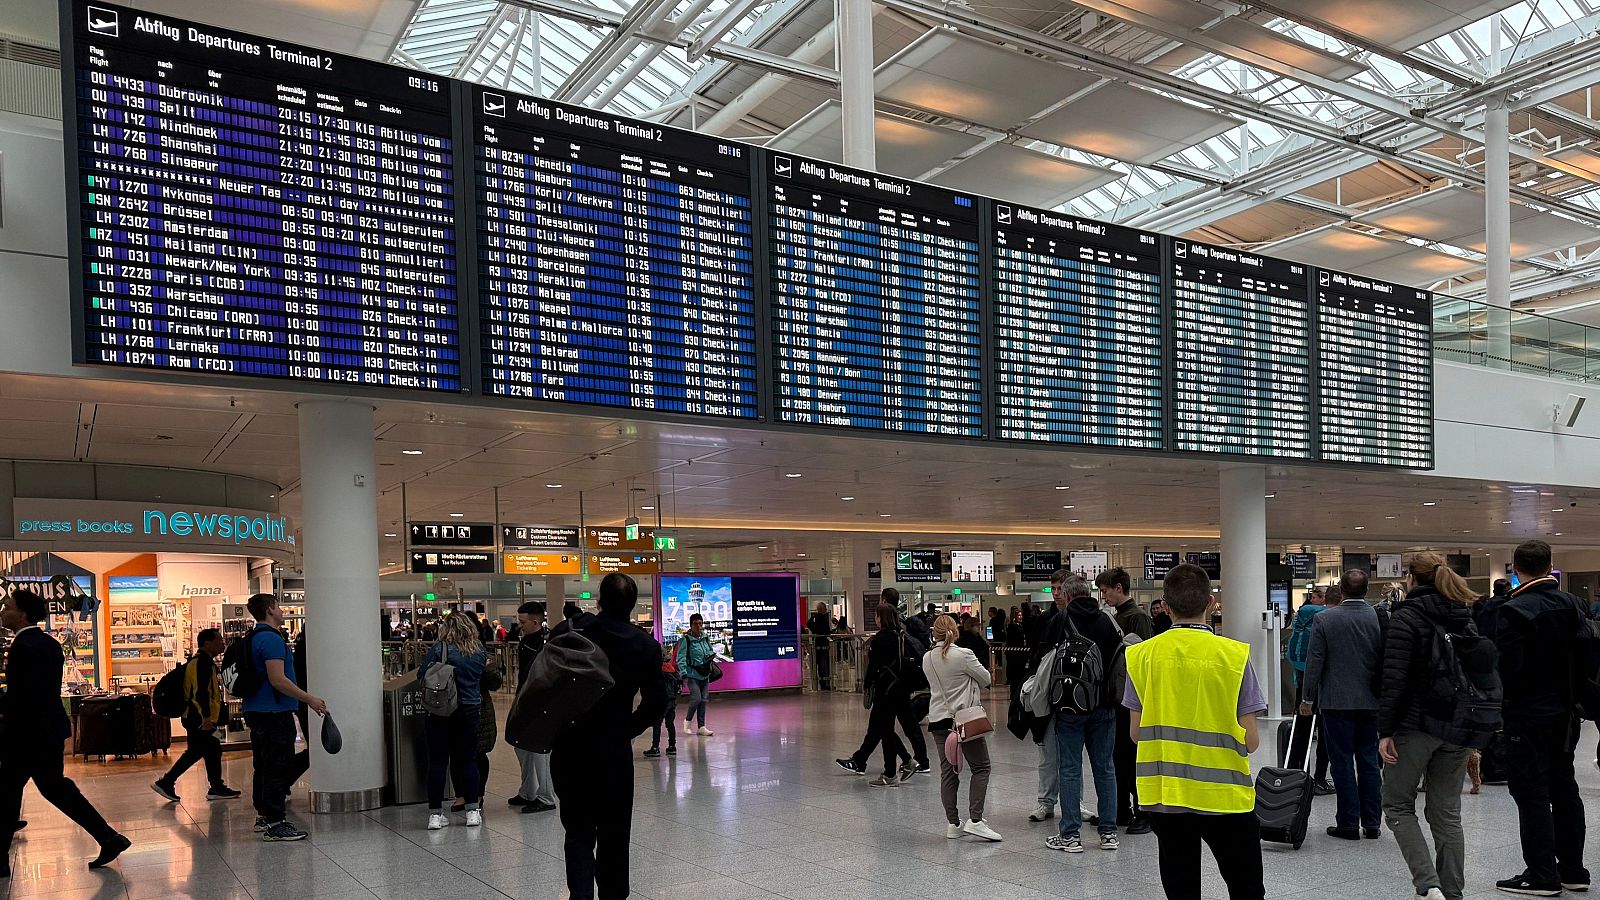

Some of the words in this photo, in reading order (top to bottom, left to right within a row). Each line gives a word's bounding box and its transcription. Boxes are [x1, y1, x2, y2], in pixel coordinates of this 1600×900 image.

[90, 46, 104, 56] Flug
[134, 16, 179, 41] Abflug
[188, 27, 260, 55] Departures
[267, 44, 320, 68] Terminal
[324, 57, 332, 70] 2
[90, 56, 108, 66] Flight
[158, 61, 173, 69] nach
[408, 76, 438, 92] 09:16
[90, 71, 106, 85] OU
[113, 75, 144, 92] 4433
[158, 84, 223, 107] Dubrovnik
[278, 107, 311, 123] 20:15
[318, 114, 349, 130] 17:30
[355, 121, 374, 135] K16
[380, 126, 417, 143] Abflug
[422, 137, 440, 148] vom
[278, 94, 306, 105] scheduled
[317, 102, 344, 112] estimated
[355, 99, 368, 108] Gate
[380, 104, 402, 114] Check-in
[516, 99, 549, 119] Abflug
[556, 107, 608, 130] Departures
[613, 120, 653, 139] Terminal
[656, 129, 662, 141] 2
[92, 124, 108, 137] LH
[123, 129, 146, 143] 726
[160, 136, 217, 155] Shanghai
[280, 156, 312, 171] 22:20
[320, 162, 351, 178] 14:00
[357, 169, 376, 182] L03
[382, 173, 418, 189] Abflug
[424, 182, 442, 193] vom
[718, 144, 740, 157] 09:16
[799, 161, 825, 179] Abflug
[829, 168, 870, 186] Departures
[873, 177, 903, 194] Terminal
[905, 185, 910, 195] 2
[219, 179, 254, 193] Neuer
[260, 185, 280, 198] Tag
[307, 194, 332, 206] next
[339, 198, 358, 210] day
[95, 195, 111, 206] SN
[118, 198, 148, 212] 2642
[163, 204, 212, 220] Brüssel
[282, 221, 315, 235] 08:55
[321, 227, 353, 241] 09:20
[359, 232, 378, 244] K15
[384, 237, 444, 254] aufgerufen
[487, 206, 498, 217] A3
[509, 209, 524, 222] 501
[536, 214, 598, 234] Thessaloniki
[624, 229, 648, 243] 10:15
[680, 239, 695, 251] K16
[699, 242, 735, 258] Check-in
[1017, 208, 1037, 224] Abflug
[1040, 213, 1073, 229] Departures
[1075, 220, 1100, 234] Terminal
[1101, 225, 1105, 235] 2
[1191, 244, 1207, 257] Abflug
[1210, 248, 1236, 261] Departures
[1238, 253, 1258, 266] Terminal
[1259, 258, 1262, 266] 2
[98, 247, 113, 258] UA
[128, 250, 149, 262] 031
[165, 255, 236, 273] Newark/New
[244, 265, 270, 277] York
[284, 270, 317, 283] 09:35
[324, 275, 355, 288] 11:45
[361, 279, 380, 291] H02
[386, 282, 434, 297] Check-in
[1332, 273, 1346, 285] Abflug
[1348, 276, 1370, 289] Departures
[1372, 282, 1388, 293] Terminal
[1389, 284, 1392, 293] 2
[101, 332, 116, 344] LH
[125, 334, 154, 348] 1768
[168, 338, 218, 353] Larnaka
[288, 349, 320, 362] 10:00
[364, 356, 383, 368] H38
[388, 358, 437, 373] Check-in
[491, 339, 503, 350] LH
[509, 341, 530, 353] 1734
[540, 344, 578, 358] Belgrad
[629, 355, 652, 367] 10:45
[685, 361, 699, 372] H30
[703, 364, 739, 377] Check-in
[492, 354, 503, 365] LH
[508, 355, 531, 368] 2434
[541, 359, 578, 373] Billund
[629, 369, 653, 381] 10:55
[685, 375, 700, 386] K16
[704, 377, 740, 390] Check-in
[20, 520, 72, 534] press
[77, 519, 134, 533] books
[143, 510, 286, 544] newspoint
[181, 584, 222, 595] hama
[668, 601, 728, 622] ZERO
